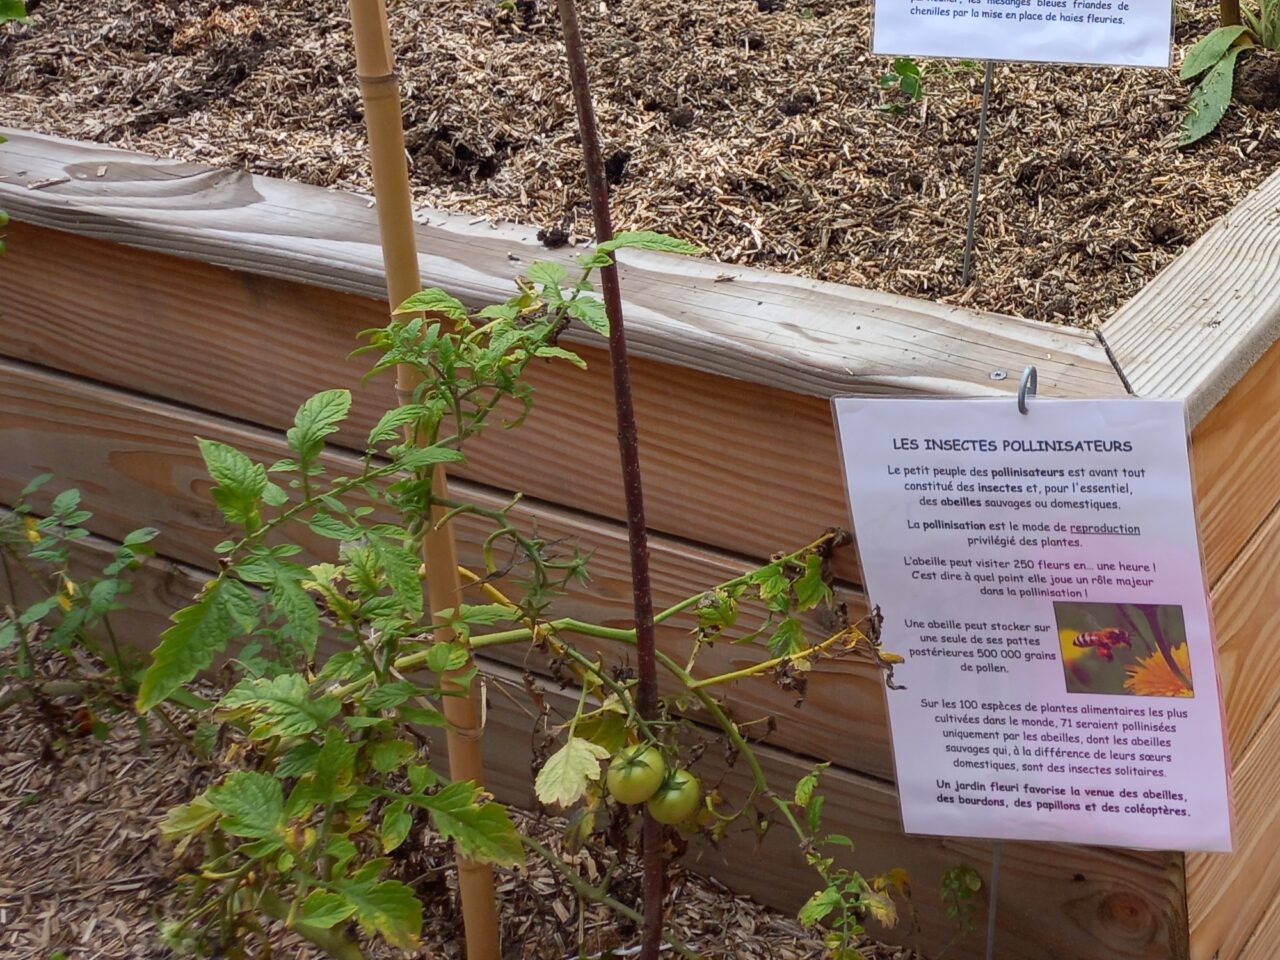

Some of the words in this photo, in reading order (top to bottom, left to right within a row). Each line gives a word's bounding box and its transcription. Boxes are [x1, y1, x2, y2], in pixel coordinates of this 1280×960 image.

[1117, 0, 1129, 11] de
[892, 437, 919, 450] LES
[923, 438, 997, 452] INSECTES
[1002, 439, 1132, 452] POLLINISATEURS
[887, 464, 901, 475] Le
[903, 465, 930, 477] petit
[932, 465, 966, 478] peuple
[969, 466, 988, 476] des
[990, 466, 1064, 480] pollinisateurs
[1067, 467, 1085, 477] est
[1088, 468, 1118, 477] avant
[1121, 467, 1145, 477] tout
[904, 480, 953, 491] constitué
[956, 480, 975, 492] des
[977, 482, 1023, 493] insectes
[1025, 483, 1041, 494] et,
[1044, 484, 1069, 495] pour
[919, 495, 937, 506] des
[940, 496, 982, 507] abeilles
[984, 499, 1031, 510] sauvages
[1034, 500, 1047, 508] ou
[1050, 498, 1120, 511] domestiques.
[967, 534, 1016, 548] privilégié
[1018, 535, 1038, 546] des
[1040, 536, 1082, 548] plantes.
[904, 618, 925, 628] Une
[927, 619, 961, 629] abeille
[963, 621, 987, 632] peut
[990, 621, 1031, 631] stocker
[1033, 624, 1051, 632] sur
[940, 633, 967, 643] seule
[969, 634, 983, 644] de
[985, 636, 1003, 644] ses
[1005, 636, 1040, 647] pattes
[908, 646, 974, 658] postérieures
[976, 648, 998, 658] 500
[1000, 648, 1021, 659] 000
[1024, 650, 1056, 662] grains
[959, 662, 973, 671] de
[975, 662, 1008, 674] pollen.
[934, 713, 980, 724] cultivées
[982, 714, 1006, 725] dans
[1008, 715, 1018, 726] le
[1021, 716, 1058, 728] monde,
[1059, 717, 1072, 727] 71
[1075, 719, 1118, 730] seraient
[1121, 720, 1176, 733] pollinisées
[952, 757, 1018, 772] domestiques,
[1021, 762, 1043, 771] sont
[1046, 762, 1065, 773] des
[1068, 763, 1111, 775] insectes
[1114, 765, 1166, 777] solitaires.
[936, 793, 954, 803] des
[957, 794, 1008, 808] bourdons,
[1013, 797, 1032, 808] des
[1035, 799, 1080, 812] papillons
[1084, 802, 1096, 811] et
[1100, 801, 1120, 813] des
[1124, 802, 1190, 817] coléoptères.
